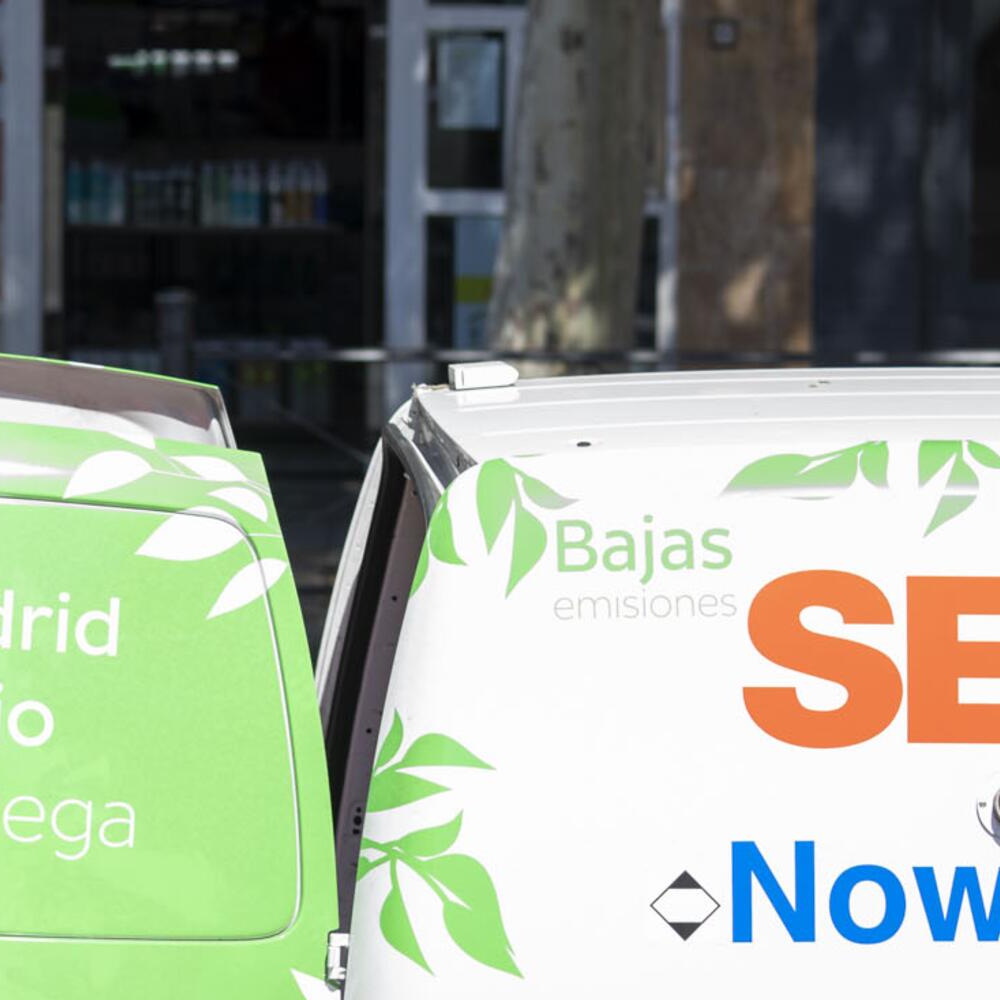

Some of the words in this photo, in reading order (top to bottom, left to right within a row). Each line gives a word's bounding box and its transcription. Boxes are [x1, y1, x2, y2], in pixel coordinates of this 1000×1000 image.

[556, 514, 733, 586] Bajas
[553, 588, 738, 621] emisiones
[743, 569, 1000, 749] SE
[731, 839, 1000, 945] Now
